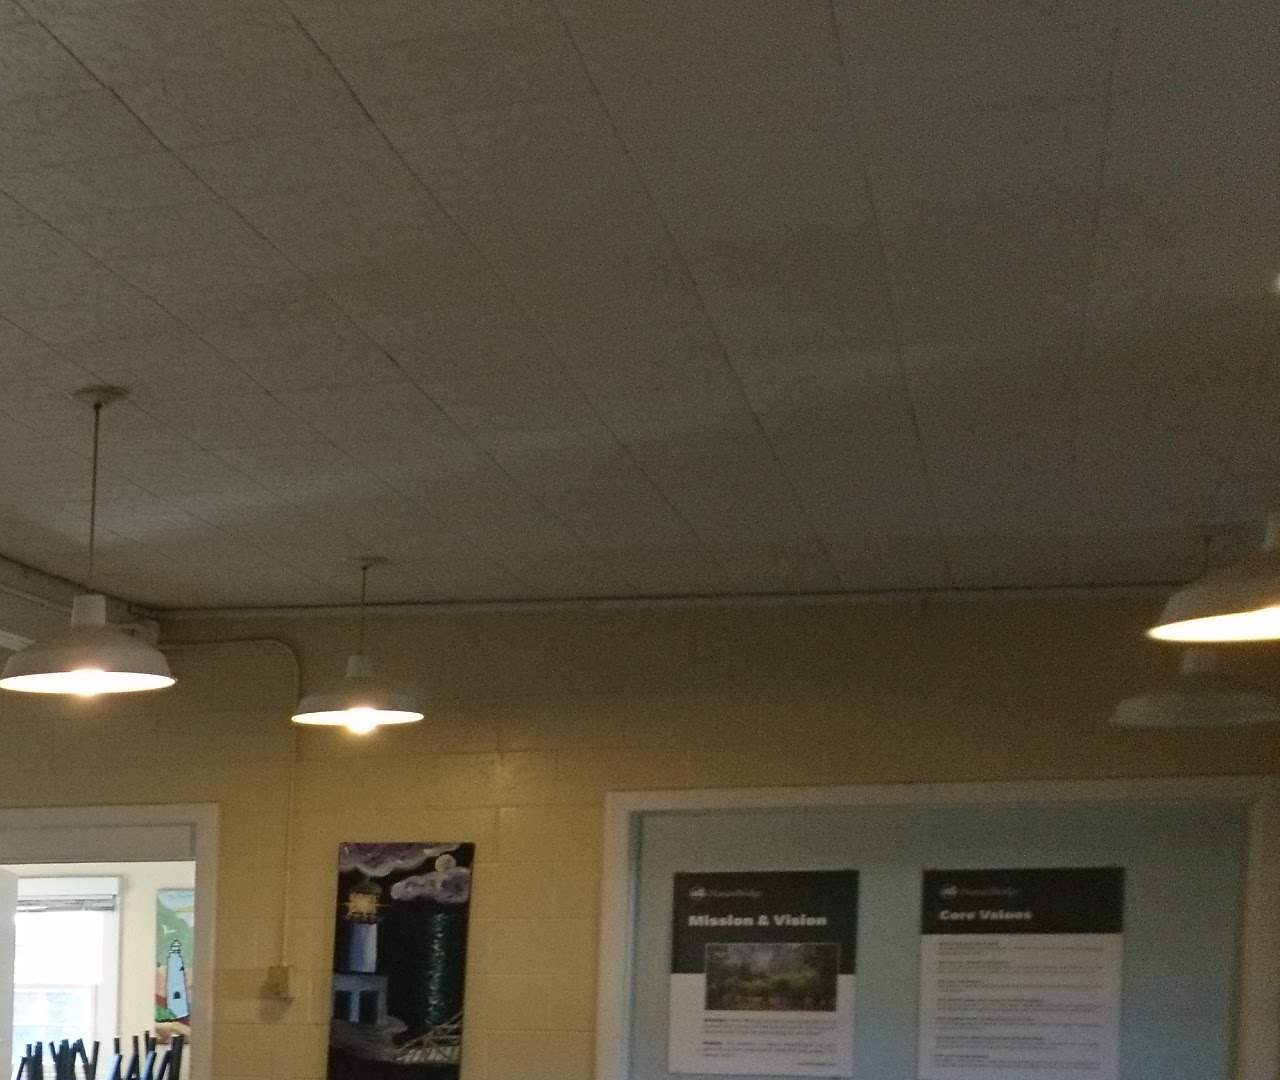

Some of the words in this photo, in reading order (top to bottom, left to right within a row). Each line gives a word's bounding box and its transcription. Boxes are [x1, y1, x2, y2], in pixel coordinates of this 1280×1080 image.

[688, 914, 754, 926] Mission
[758, 914, 770, 926] &
[773, 913, 828, 926] Vision
[939, 909, 976, 920] Core
[979, 909, 1033, 920] Values
